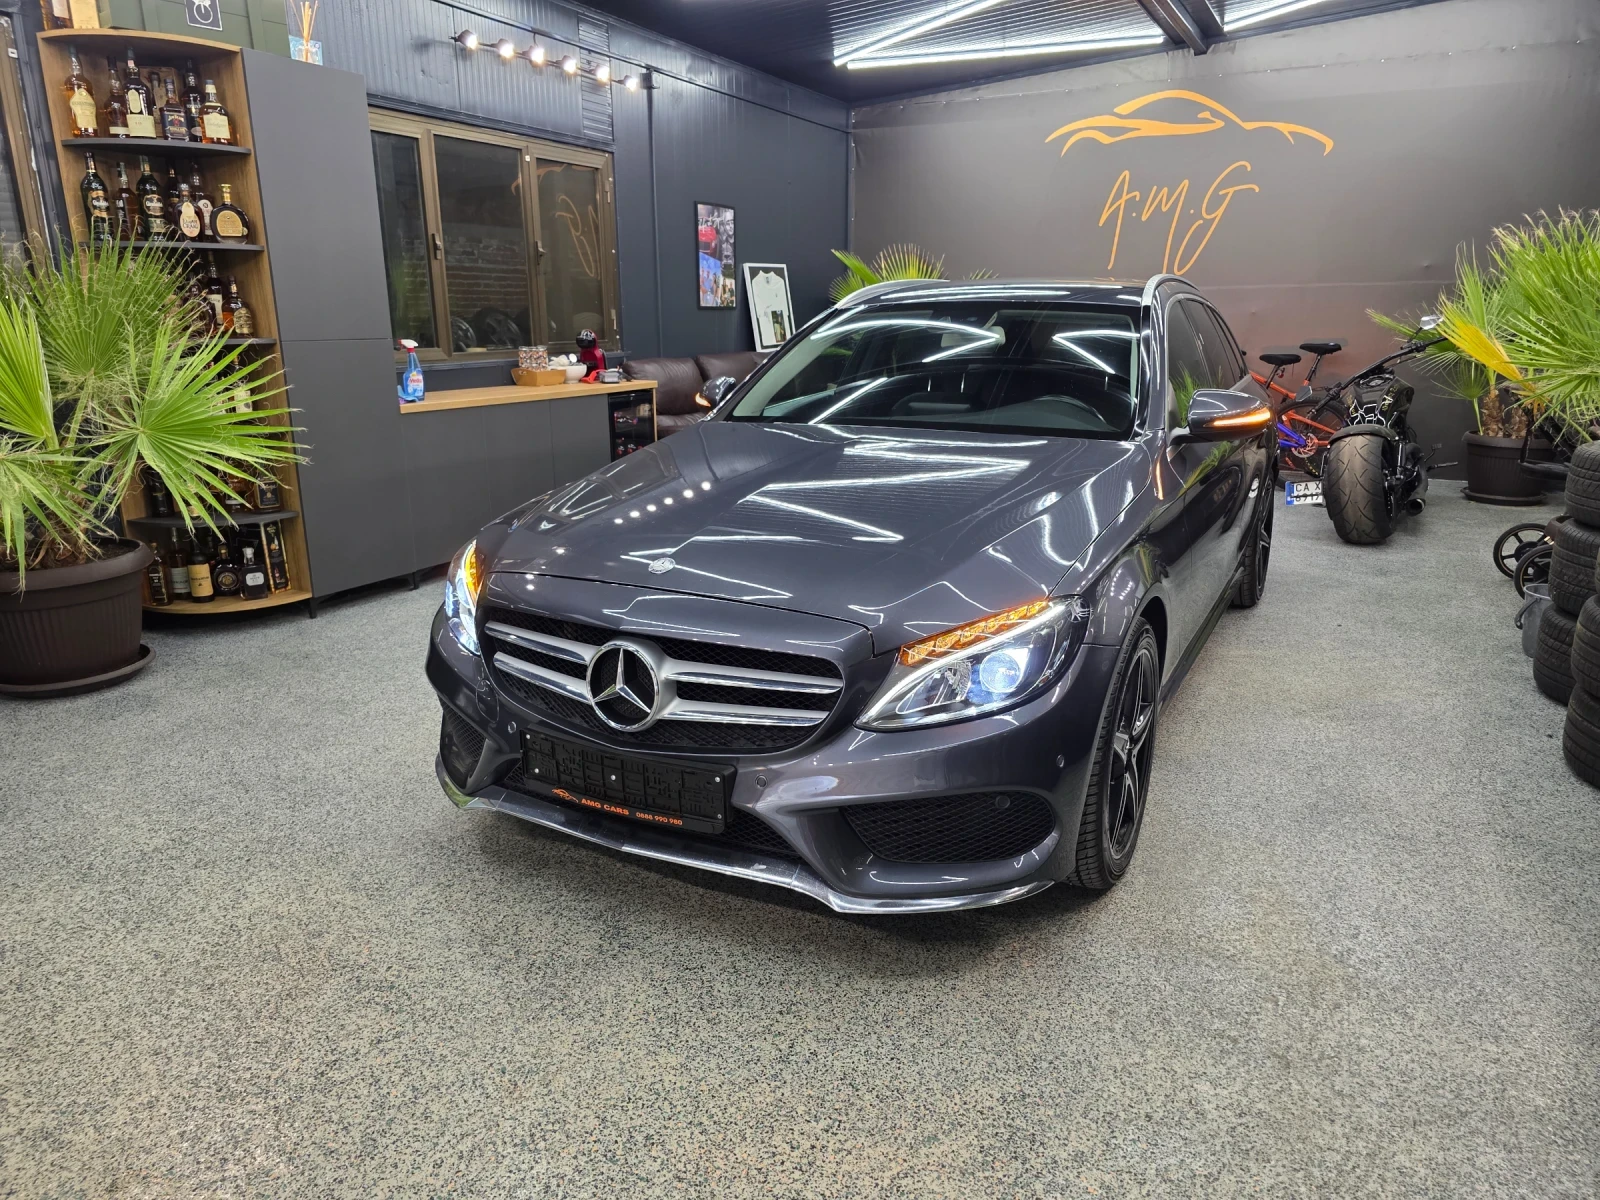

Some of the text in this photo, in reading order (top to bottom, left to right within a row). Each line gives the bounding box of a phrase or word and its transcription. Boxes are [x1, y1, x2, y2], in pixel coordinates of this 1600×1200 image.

[1295, 482, 1310, 492] CA
[581, 798, 602, 809] AMG
[603, 804, 630, 815] CARS
[654, 815, 668, 823] 990
[669, 817, 683, 825] 980
